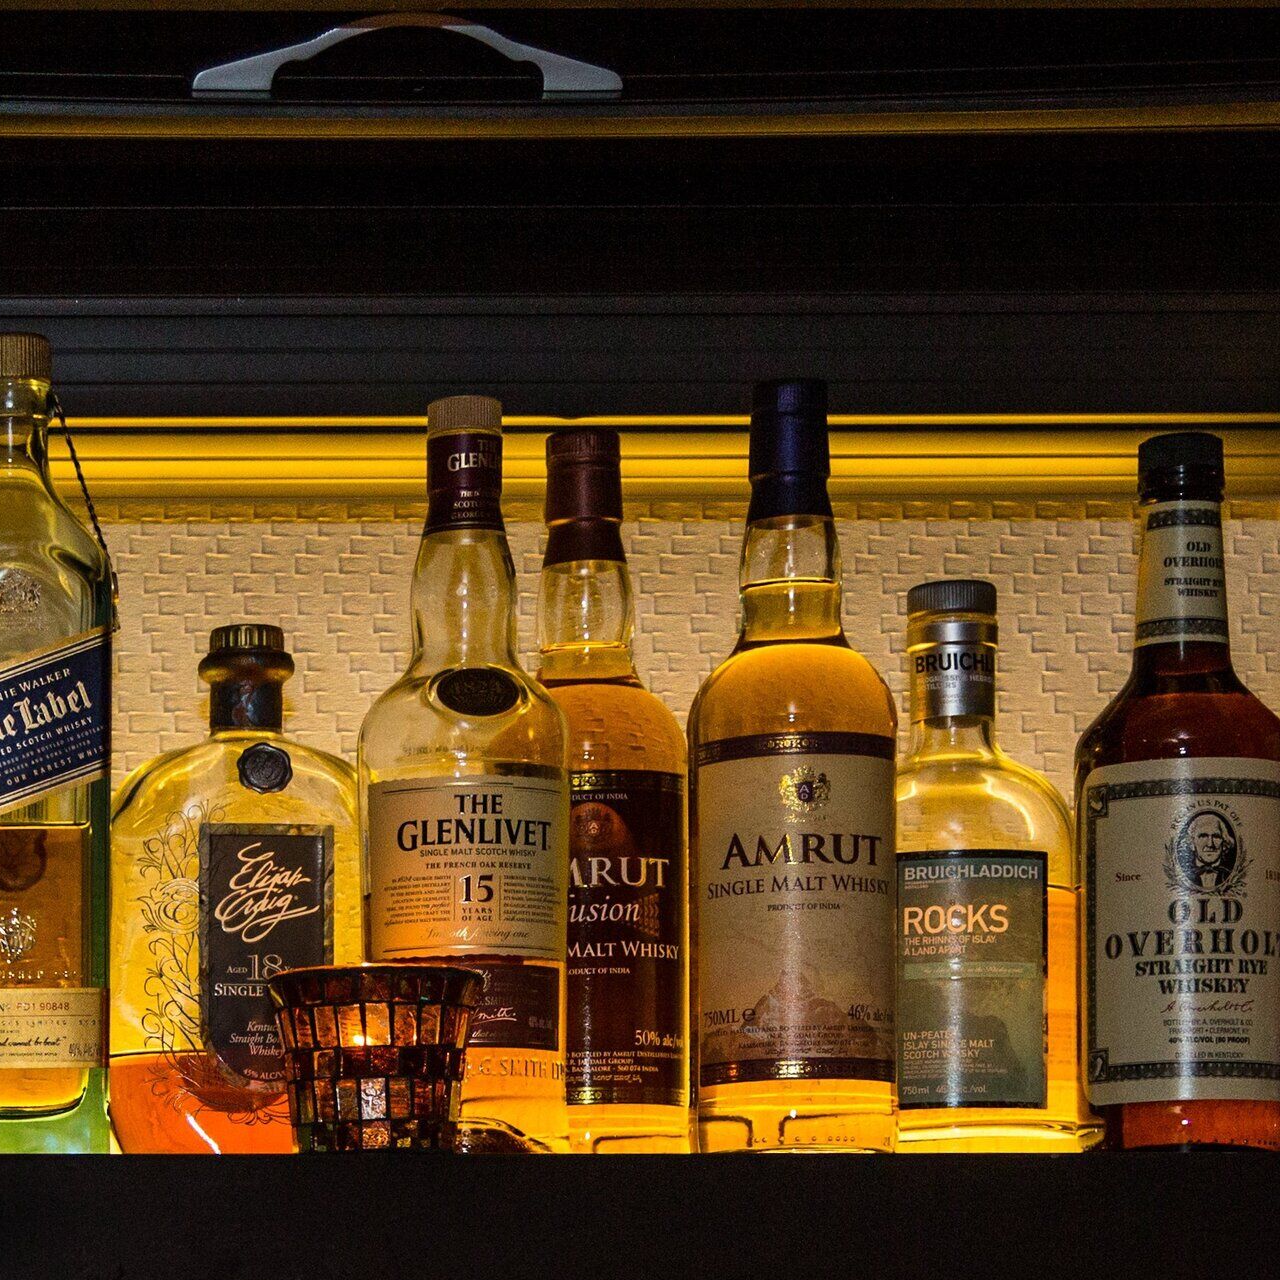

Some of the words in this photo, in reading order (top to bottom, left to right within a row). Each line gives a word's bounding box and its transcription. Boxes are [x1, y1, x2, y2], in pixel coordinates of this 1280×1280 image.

[1187, 541, 1212, 552] OLD
[1164, 557, 1224, 568] OVERHOL
[1164, 577, 1211, 587] STRAIGHT
[1178, 588, 1219, 598] WHISKEY
[19, 668, 71, 692] WALKER
[12, 680, 93, 735] Label
[16, 732, 53, 750] SCOTCH
[56, 716, 93, 735] WHISKY
[6, 773, 28, 787] OUR
[32, 757, 73, 777] RAREST
[454, 794, 503, 815] THE
[397, 819, 551, 851] GLENLIVET
[420, 849, 449, 858] SINGLE
[451, 848, 474, 857] MALT
[476, 848, 507, 857] SCOTCH
[509, 848, 537, 857] WHISKY
[720, 832, 882, 870] AMRUT
[228, 841, 311, 894] Elijah
[499, 862, 532, 870] RESERVE
[904, 864, 1038, 881] BRUICHLADDICH
[1115, 872, 1141, 883] Since
[458, 873, 495, 905] 15
[707, 878, 764, 900] SINGLE
[771, 874, 827, 893] MALT
[831, 874, 890, 896] WHISKY
[214, 886, 320, 943] Craig
[569, 894, 641, 923] usion
[807, 903, 818, 911] OF
[820, 902, 841, 911] INDIA
[1167, 898, 1243, 925] OLD
[903, 903, 1009, 936] ROCKS
[905, 937, 920, 946] THE
[959, 935, 971, 944] OF
[567, 941, 617, 958] MALT
[620, 940, 680, 960] WHISKY
[904, 948, 910, 957] A
[912, 946, 937, 957] LAND
[247, 953, 284, 982] 18
[568, 967, 597, 975] ODUCT
[1135, 958, 1234, 978] STRAIGHT
[1237, 958, 1268, 976] RYE
[214, 982, 265, 998] SINGLE
[1158, 978, 1251, 995] WHISKEY
[847, 1003, 871, 1022] 46%
[246, 1020, 280, 1034] Kentuc
[229, 1032, 264, 1048] Straight
[634, 1029, 661, 1046] 50%
[903, 1041, 929, 1051] ISLAY
[931, 1040, 967, 1049] SINE
[969, 1039, 995, 1049] MALT
[903, 1050, 940, 1060] SCOTCH
[941, 1049, 980, 1059] WSKY
